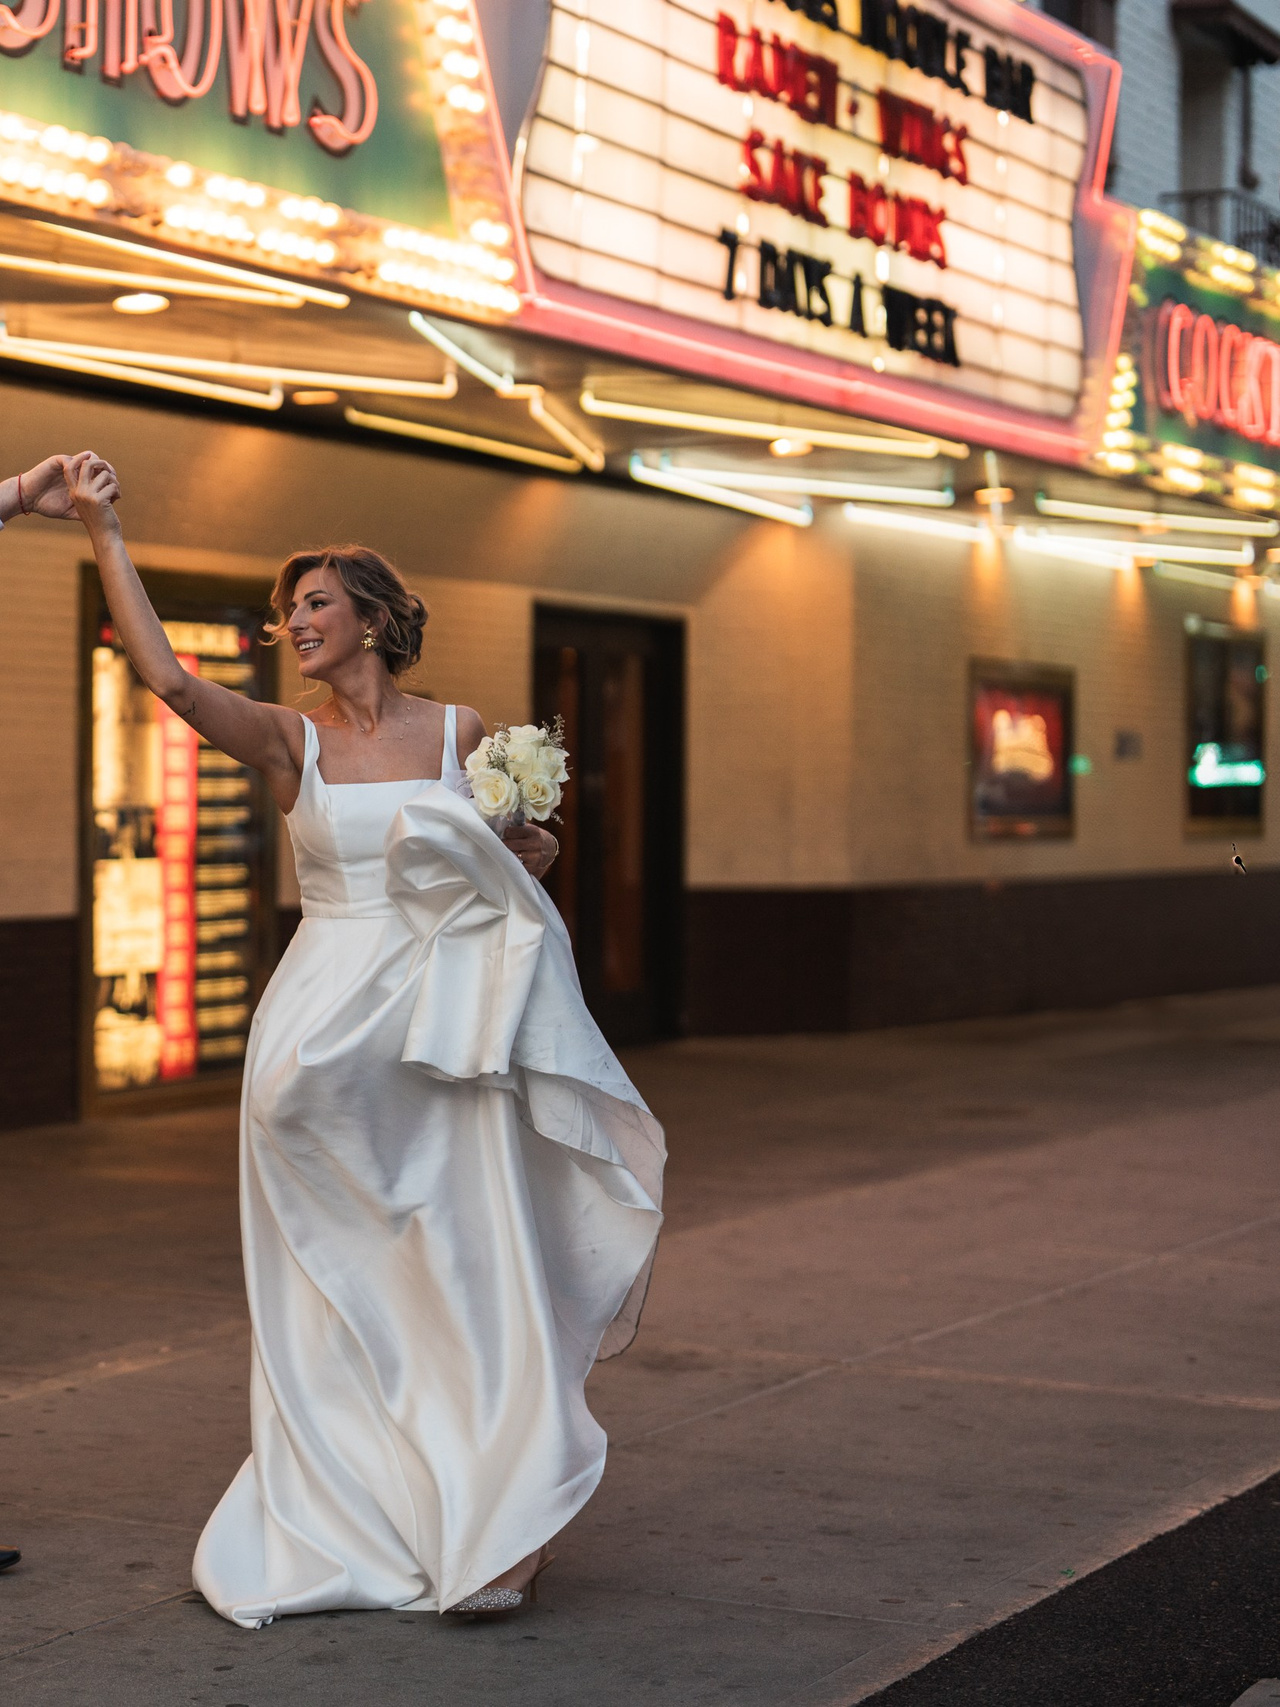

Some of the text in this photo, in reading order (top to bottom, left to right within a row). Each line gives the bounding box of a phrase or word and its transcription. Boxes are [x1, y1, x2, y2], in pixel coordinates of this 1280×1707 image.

[740, 130, 829, 228] SAKE
[718, 228, 961, 368] 7 DAYS A WEEK
